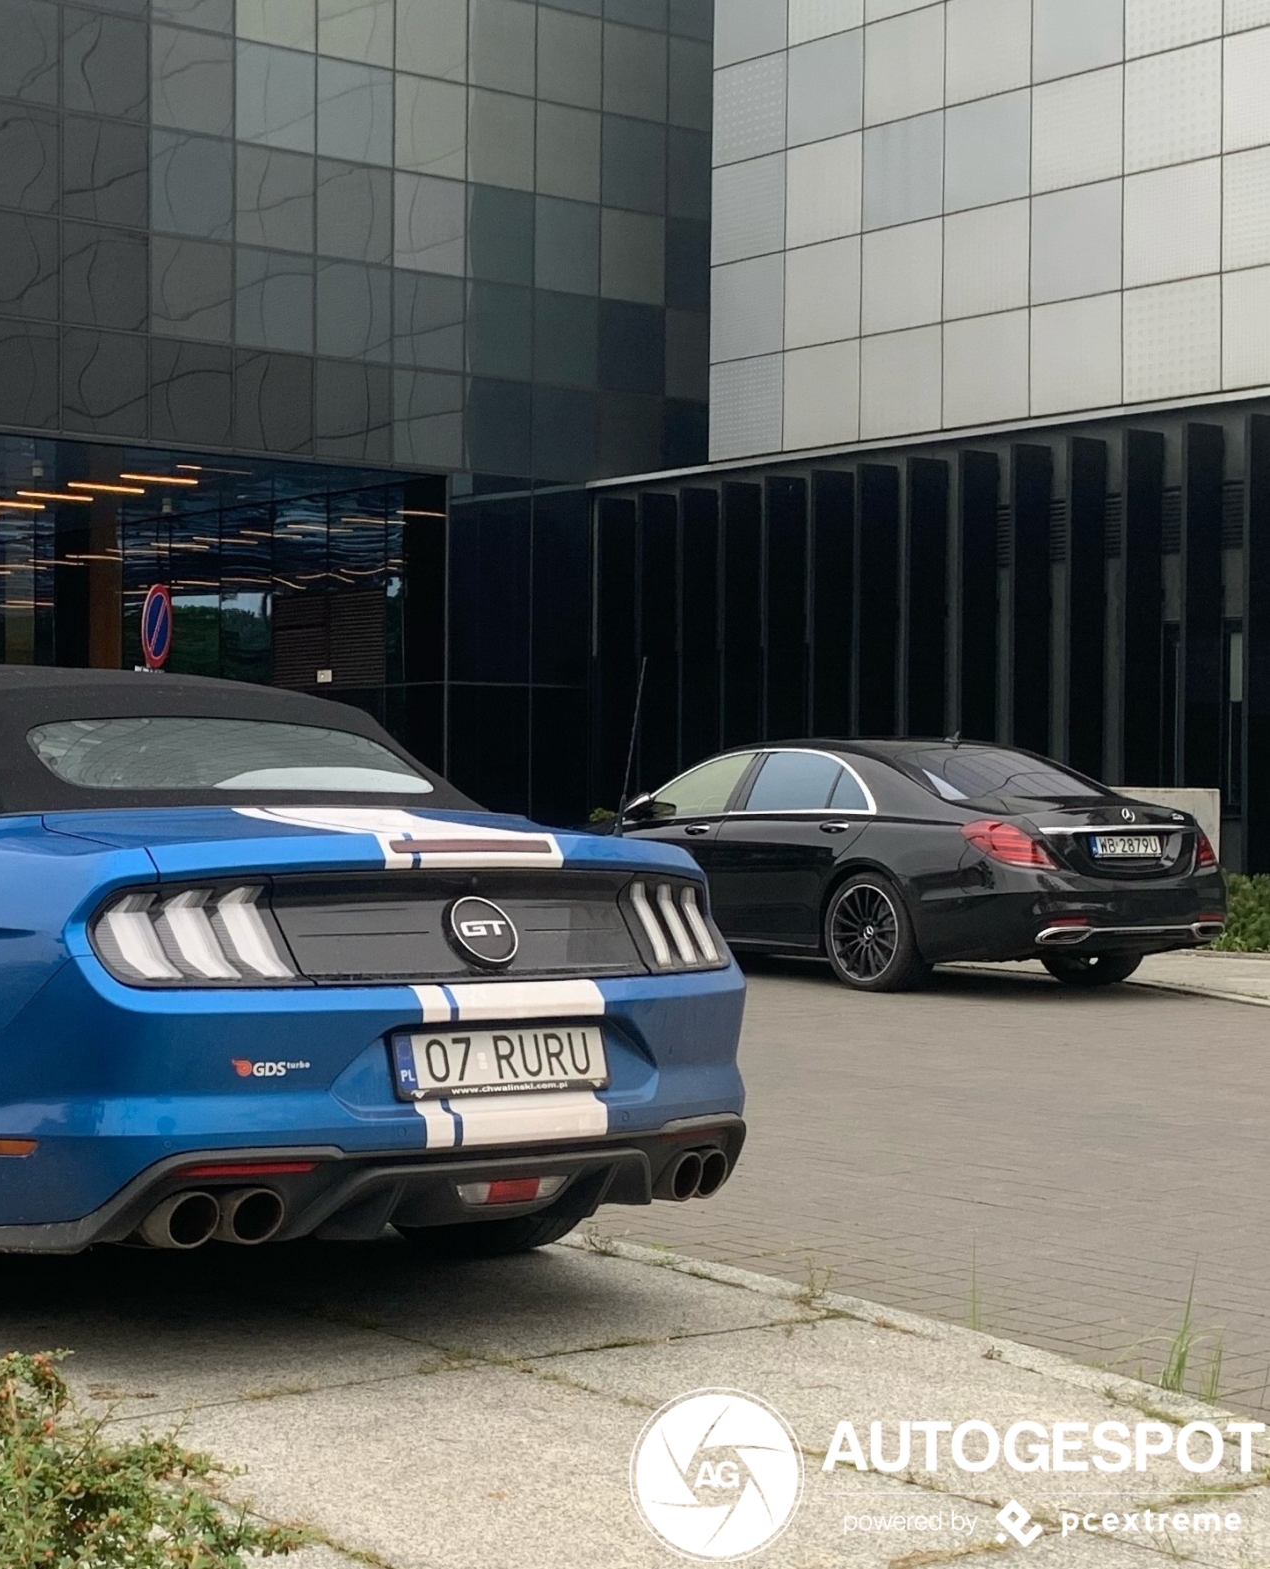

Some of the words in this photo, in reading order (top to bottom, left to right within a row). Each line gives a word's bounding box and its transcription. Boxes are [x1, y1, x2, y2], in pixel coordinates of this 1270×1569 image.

[1100, 838, 1117, 853] WB
[1119, 838, 1158, 853] 2879U
[460, 920, 506, 937] GT
[492, 1031, 591, 1080] RURU
[252, 1061, 287, 1077] GDS
[286, 1060, 311, 1069] turbo
[400, 1069, 415, 1083] PL
[451, 1081, 568, 1095] www.chwalinski.com.pl
